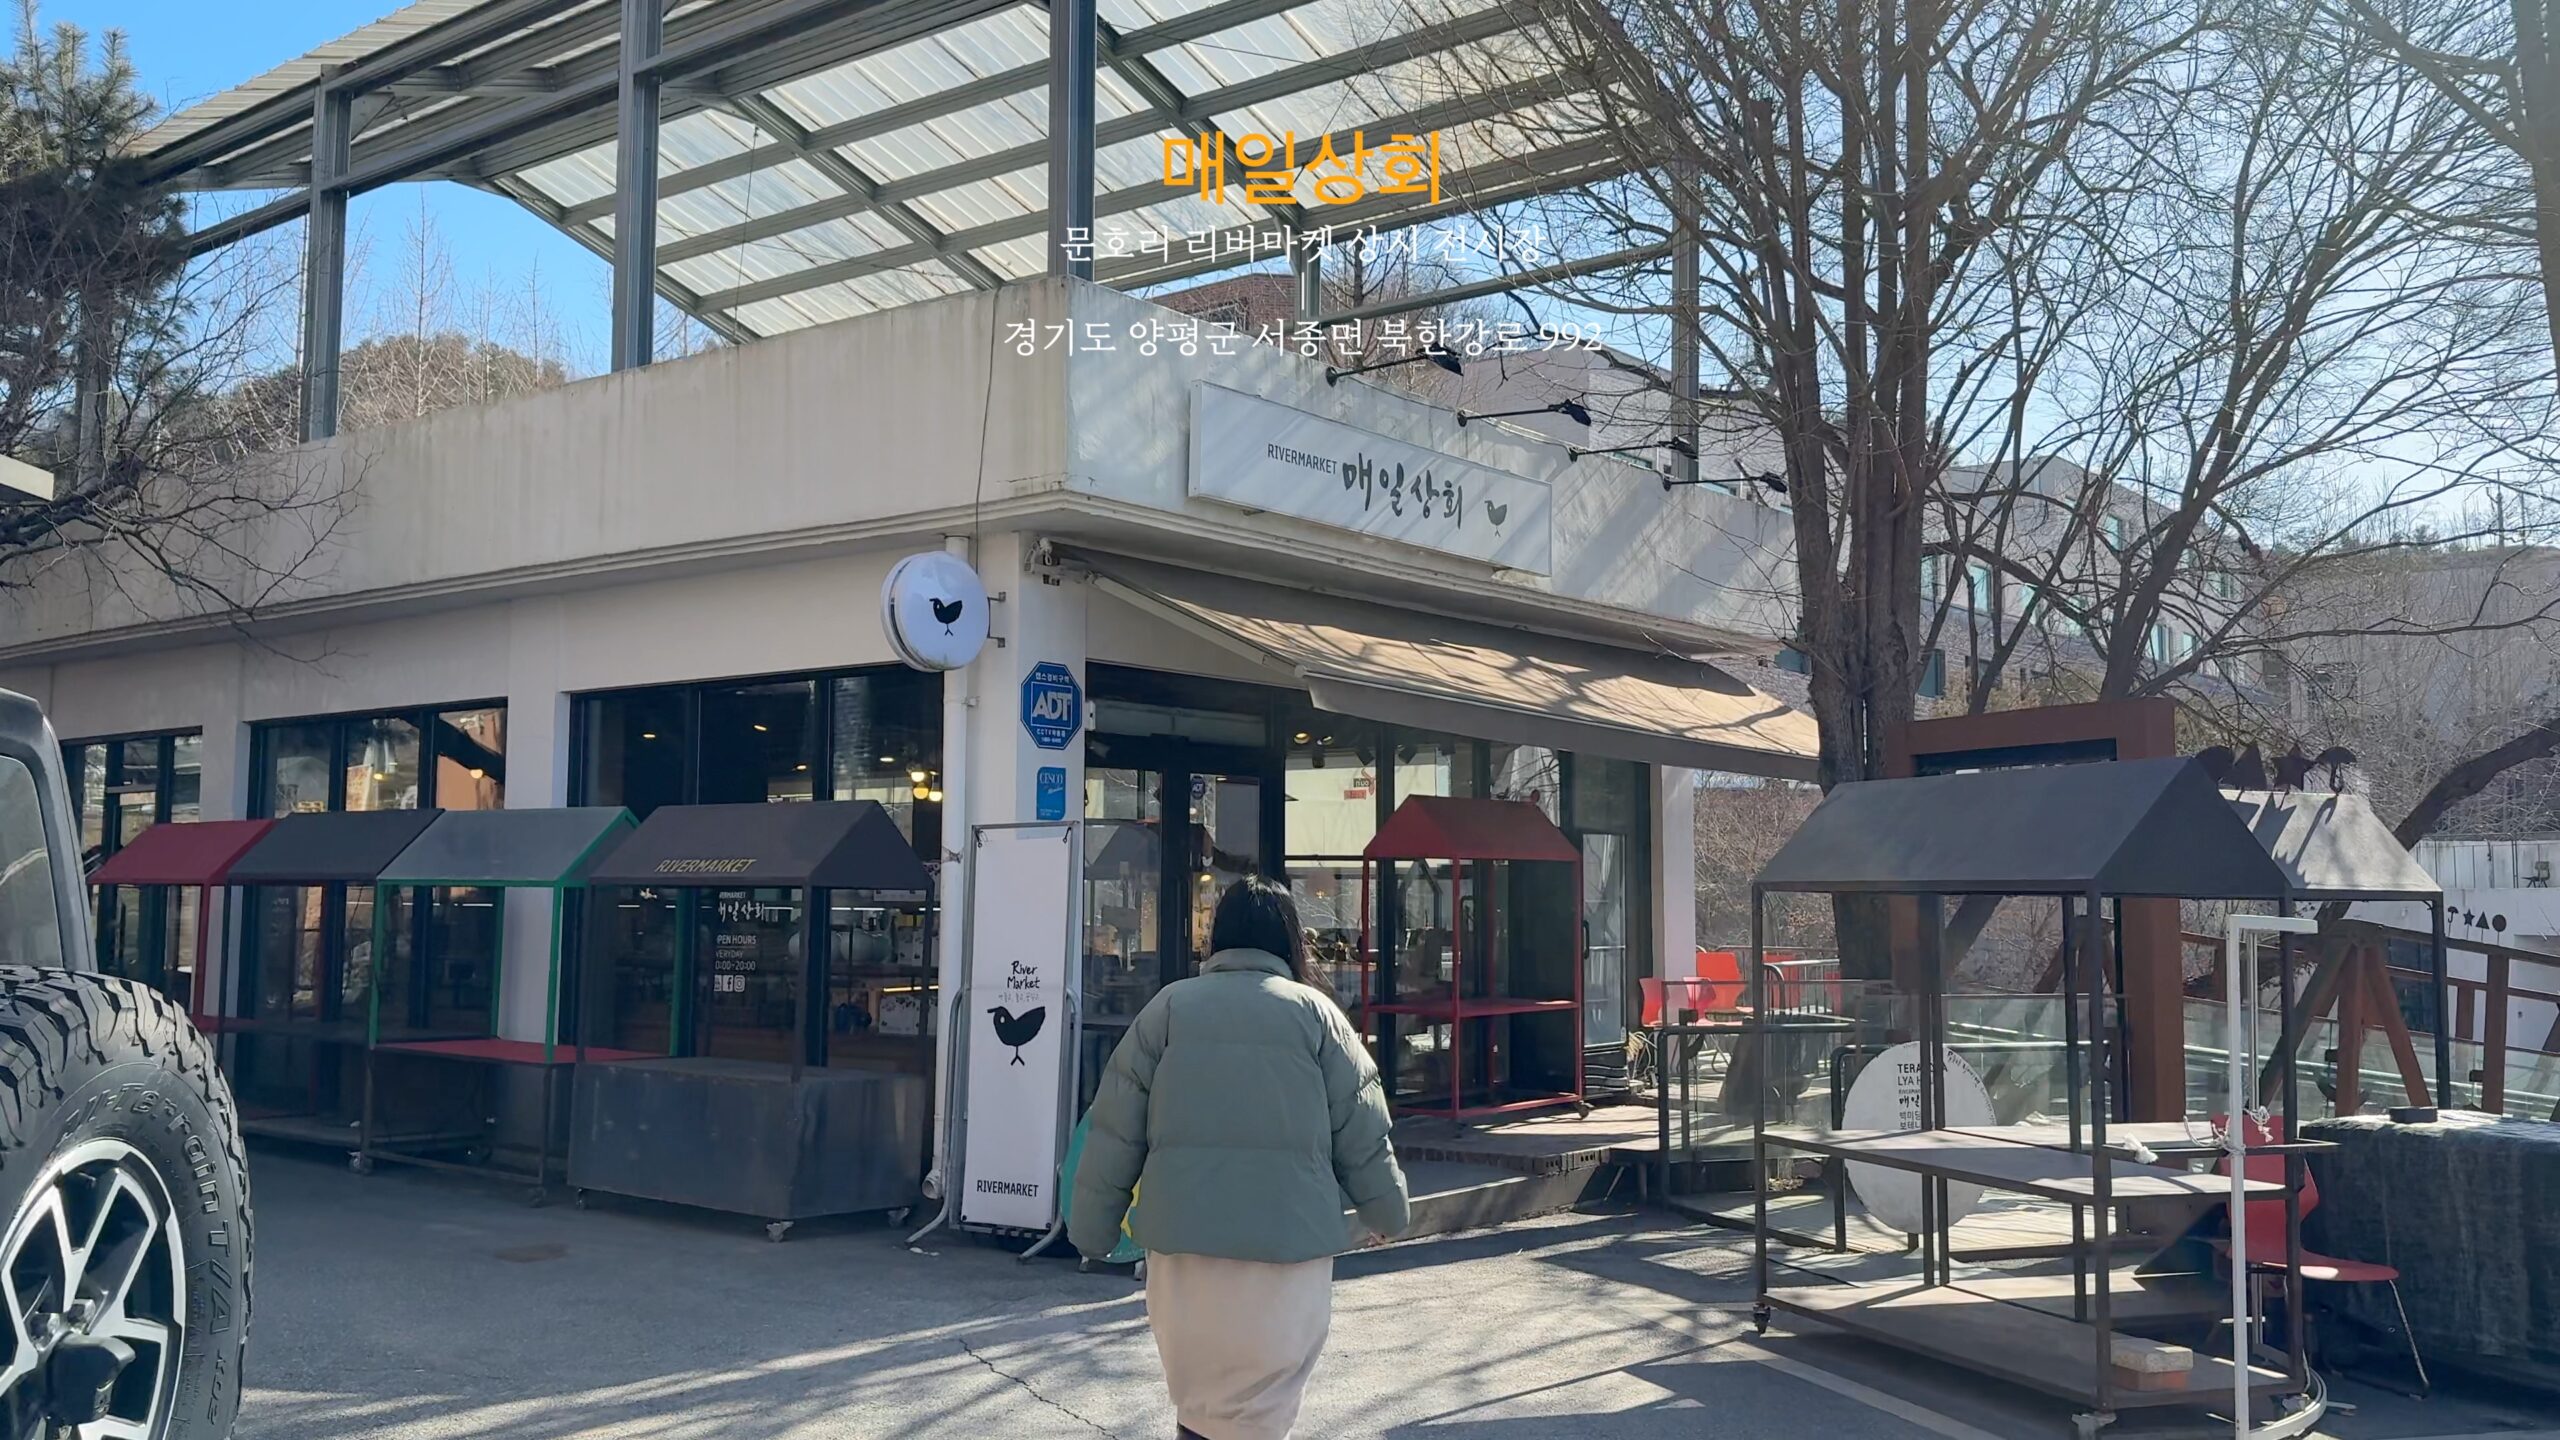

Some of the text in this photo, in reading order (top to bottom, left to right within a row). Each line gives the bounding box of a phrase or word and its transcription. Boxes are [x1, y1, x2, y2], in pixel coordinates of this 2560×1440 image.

[1267, 443, 1338, 475] RIVERMARKET
[1342, 452, 1463, 529] 매일상회
[1032, 690, 1072, 721] ADT
[654, 859, 757, 873] RIVERMARKET
[716, 934, 757, 945] PEN HOURS
[715, 949, 744, 959] VERYDAY
[1011, 960, 1038, 975] River
[1007, 975, 1041, 990] Market
[976, 1179, 1039, 1197] RIVERMARKET
